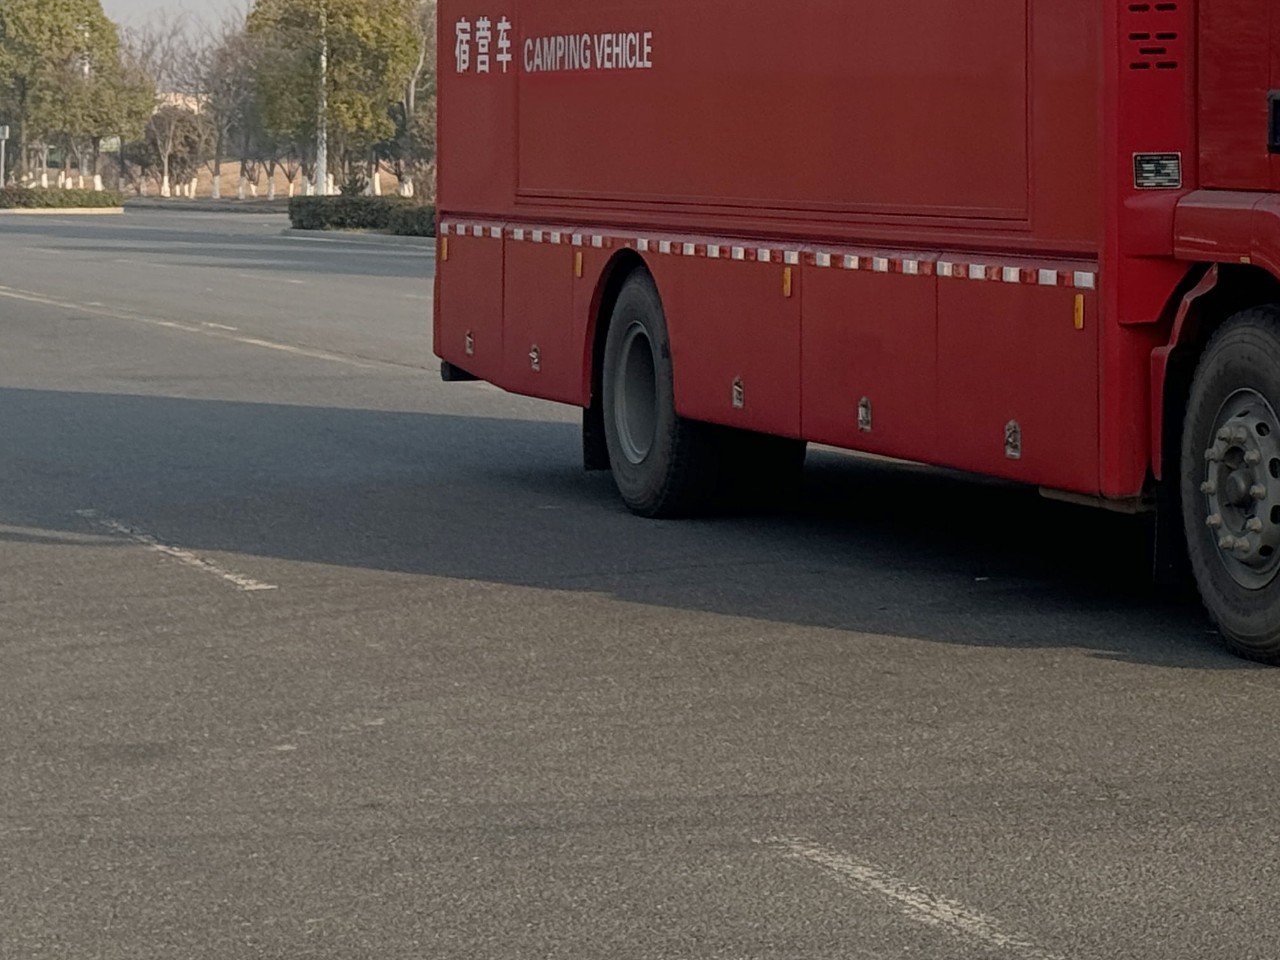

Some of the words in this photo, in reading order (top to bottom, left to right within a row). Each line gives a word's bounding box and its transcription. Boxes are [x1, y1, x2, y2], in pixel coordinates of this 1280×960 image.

[455, 16, 512, 73] 宿营车
[524, 33, 591, 72] CAMPING
[593, 31, 652, 69] VEHICLE
